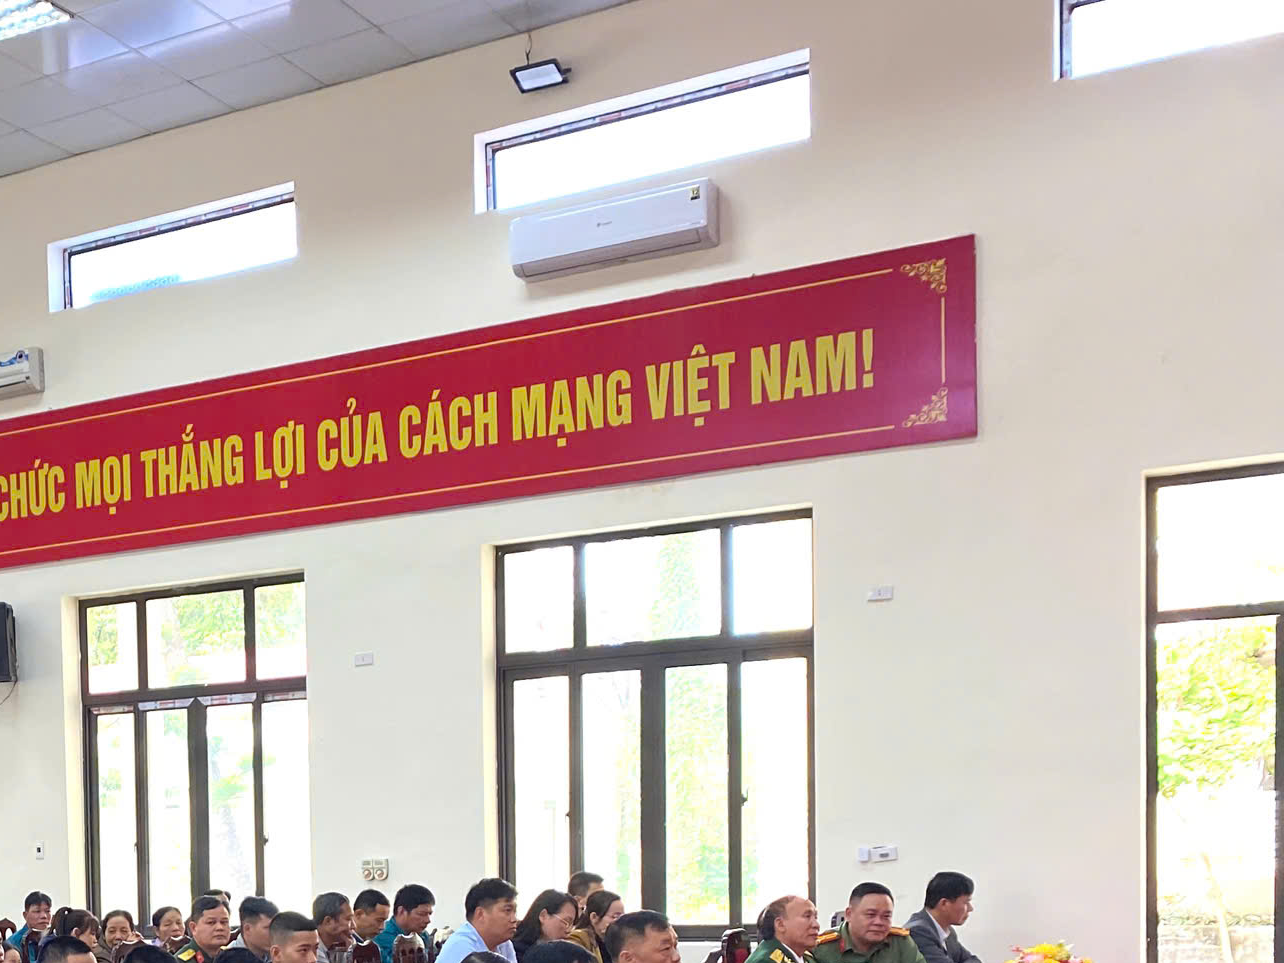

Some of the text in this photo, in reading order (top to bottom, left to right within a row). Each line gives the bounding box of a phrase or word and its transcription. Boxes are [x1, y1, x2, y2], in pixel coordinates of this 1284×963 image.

[76, 453, 132, 516] MỌI
[140, 421, 245, 498] THẮNG
[255, 420, 307, 489] LỢI
[318, 396, 388, 471] CỦA
[398, 388, 498, 459] CÁCH
[512, 369, 633, 449] MẠNG
[646, 343, 736, 427] VIỆT
[751, 329, 874, 405] NAM!
